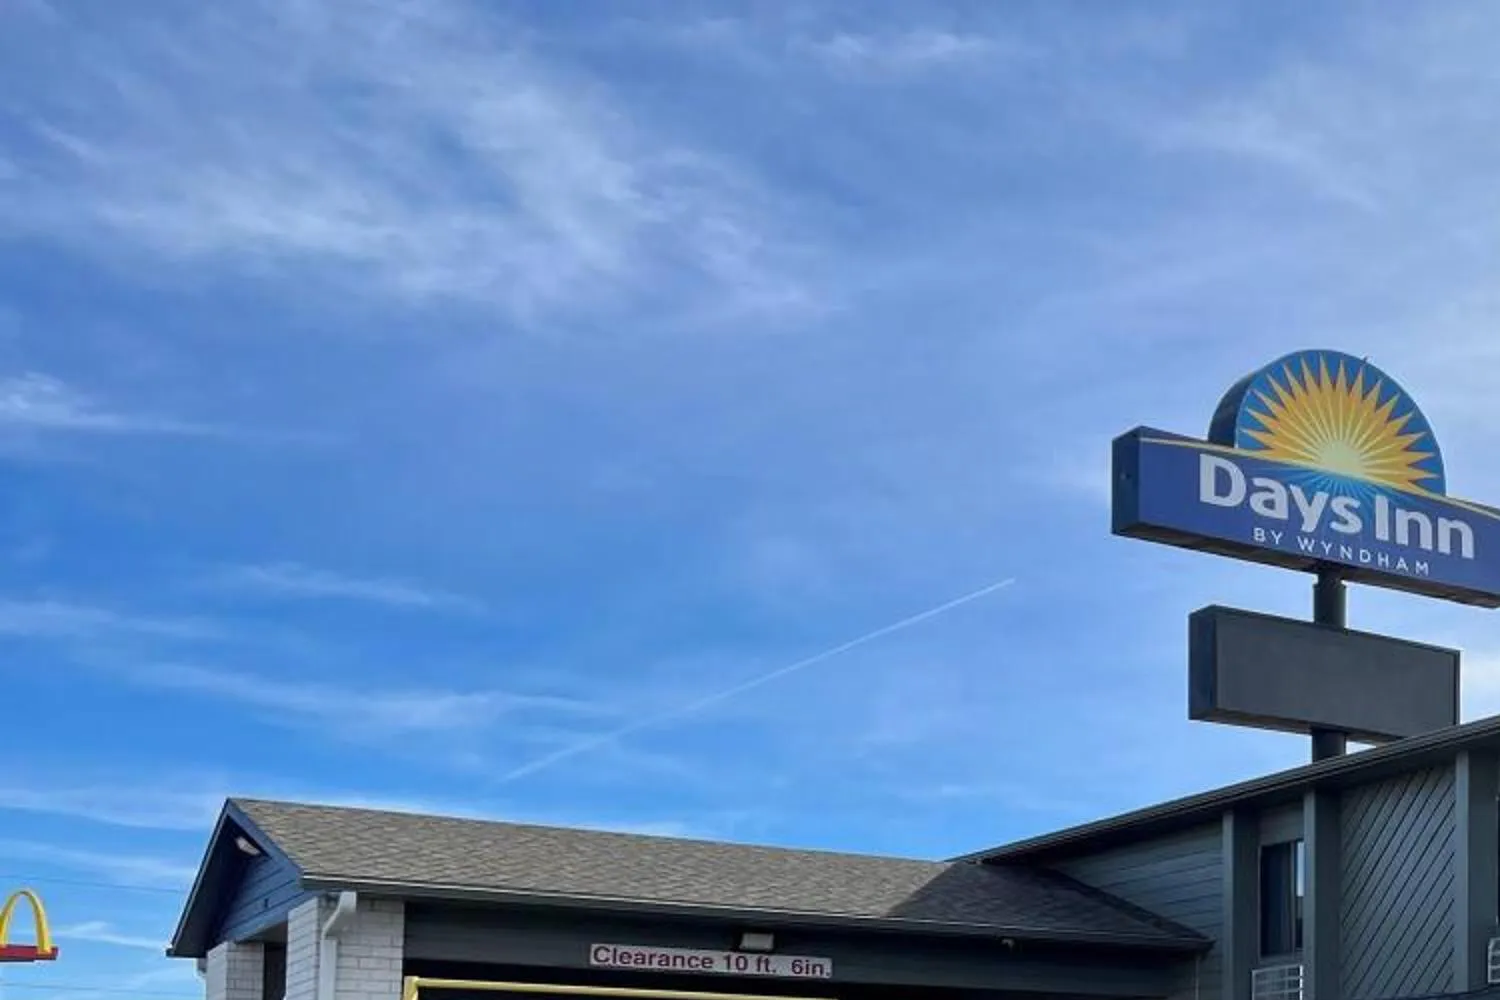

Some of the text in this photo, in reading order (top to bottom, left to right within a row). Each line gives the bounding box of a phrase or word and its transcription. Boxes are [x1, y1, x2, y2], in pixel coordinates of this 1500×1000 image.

[1199, 452, 1475, 560] Days Inn
[1253, 527, 1429, 576] BY WYNDHAM
[592, 945, 714, 969] Clearance
[723, 954, 748, 971] 10
[755, 956, 777, 973] ft.
